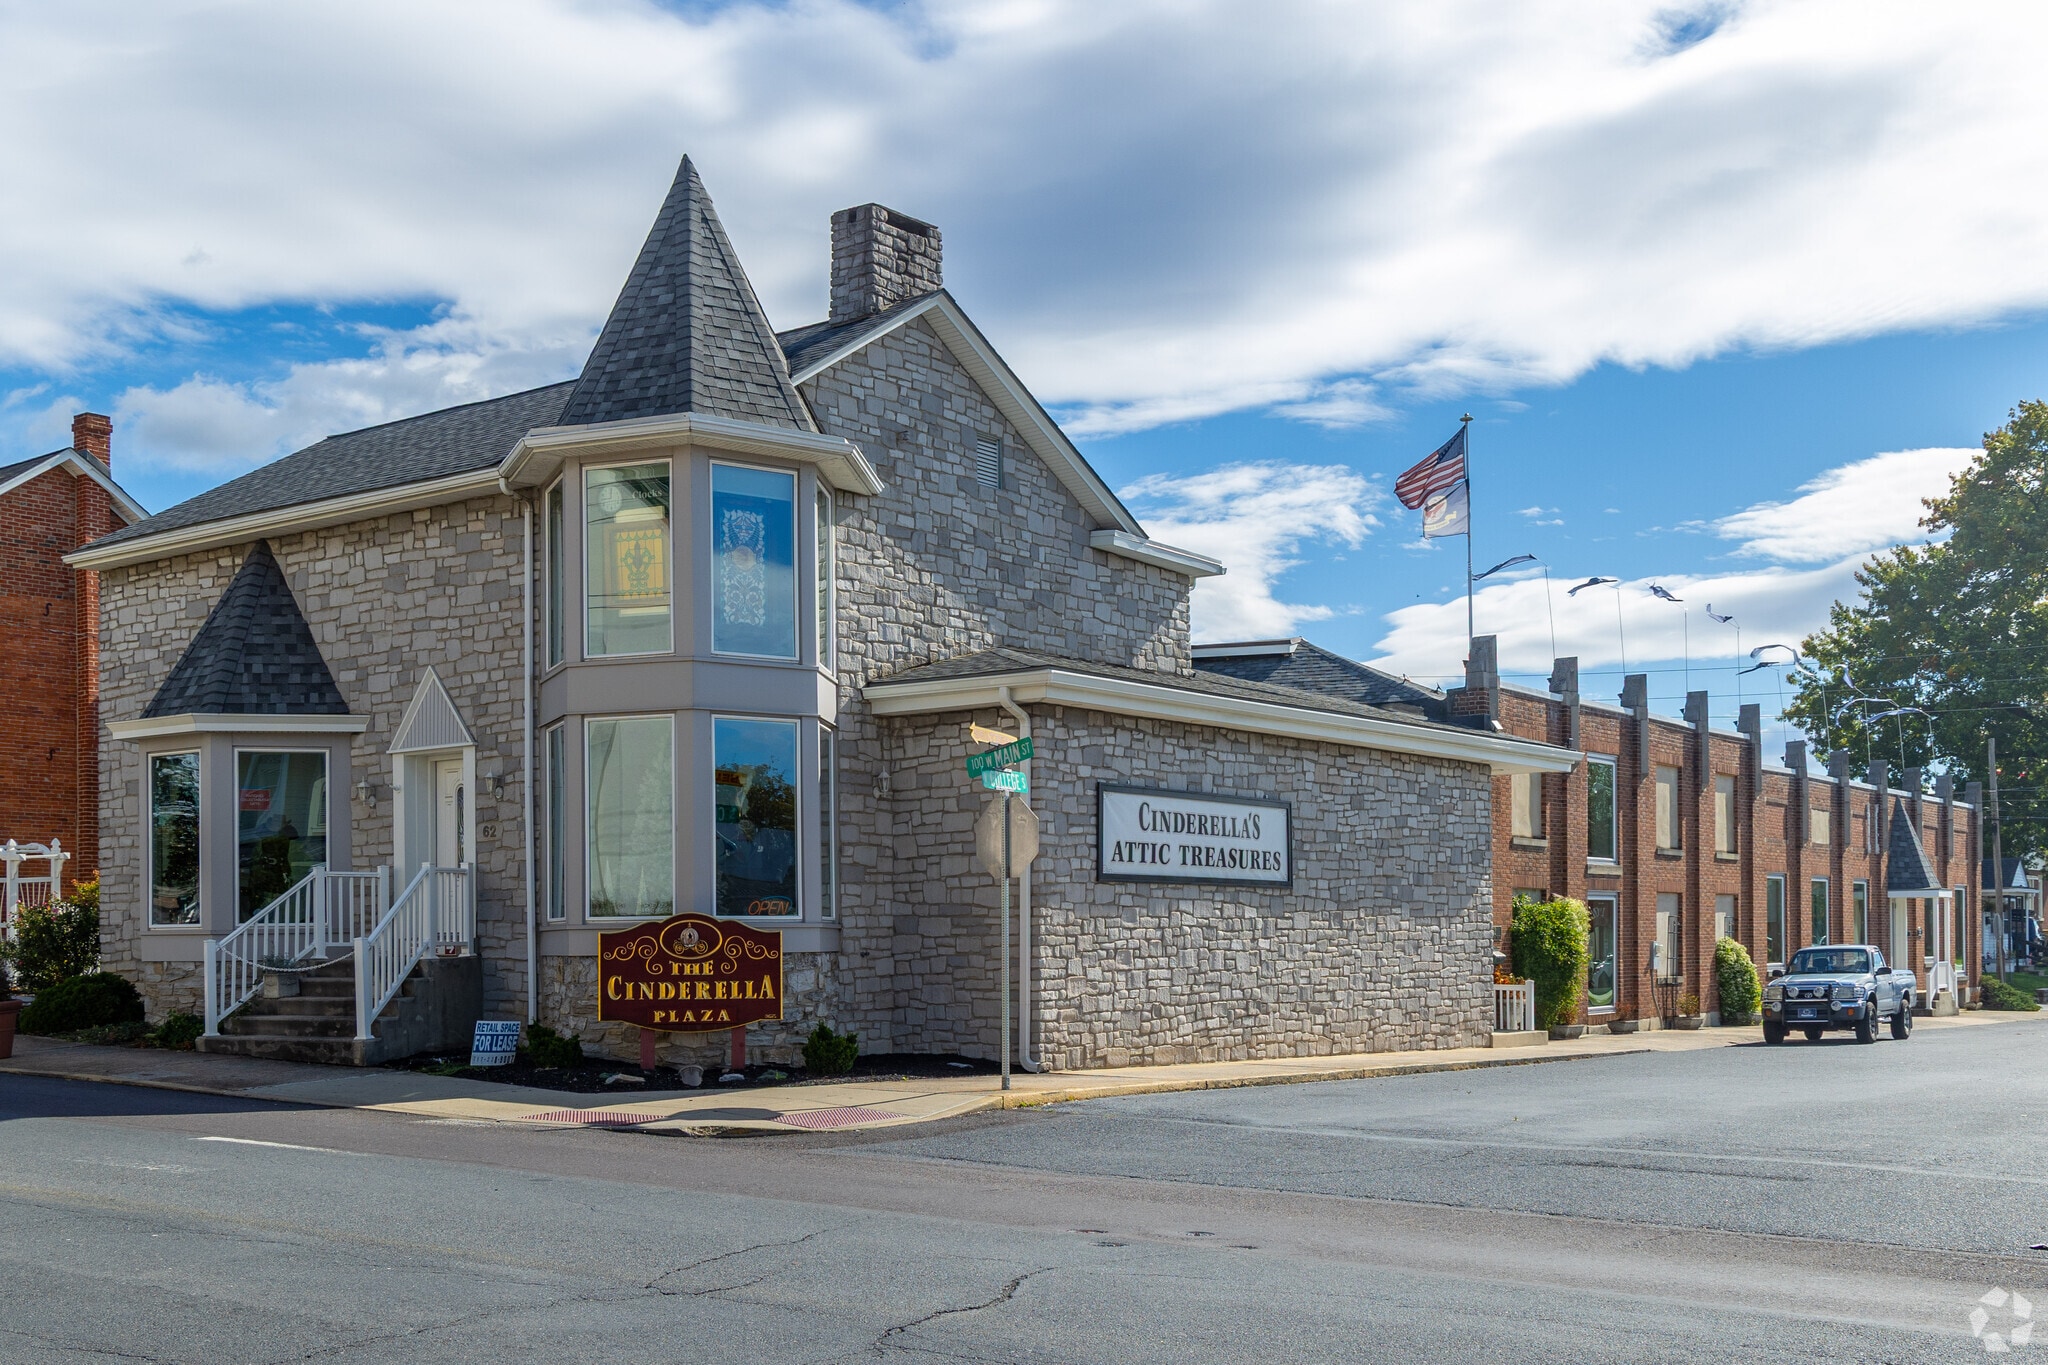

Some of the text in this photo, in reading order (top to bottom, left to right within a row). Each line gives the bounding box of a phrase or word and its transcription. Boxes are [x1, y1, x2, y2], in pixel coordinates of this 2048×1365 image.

[632, 489, 662, 499] Clocks
[971, 742, 1031, 770] 100 W MAIN ST
[1138, 802, 1261, 840] CINDERELLA'S
[482, 825, 497, 838] 62
[1111, 840, 1281, 872] ATTIC TREASURES
[748, 900, 790, 915] OPEN
[669, 960, 714, 976] THE
[607, 974, 776, 1001] CINDERELLA
[653, 1009, 731, 1023] PLAZA
[476, 1022, 520, 1033] RETAIL SPACE
[473, 1035, 519, 1052] FOR LEASE
